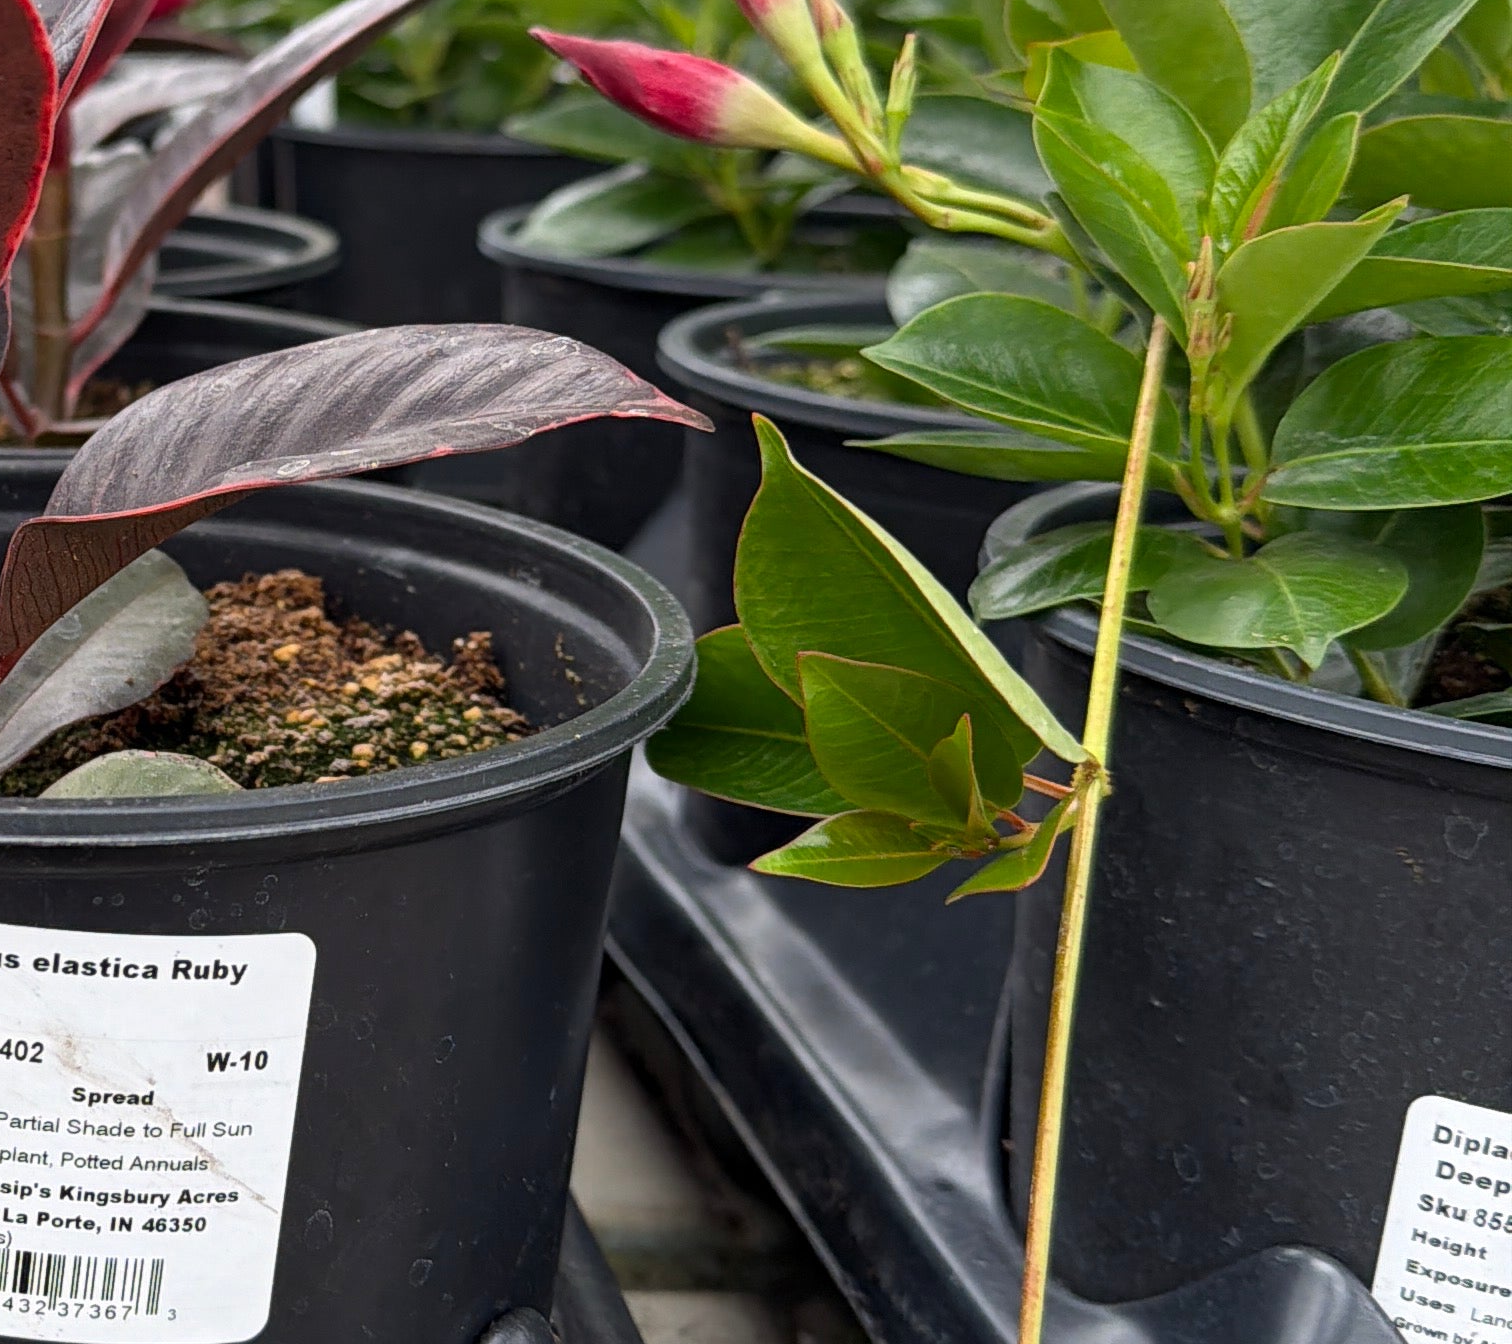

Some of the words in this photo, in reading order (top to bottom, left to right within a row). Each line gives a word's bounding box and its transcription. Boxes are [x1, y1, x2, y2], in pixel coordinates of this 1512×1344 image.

[32, 952, 159, 980] elastica
[171, 959, 249, 986] Ruby
[206, 1050, 269, 1073] W-10
[71, 1086, 155, 1108] Spread
[66, 1118, 136, 1138] Shade
[142, 1123, 163, 1138] to
[169, 1122, 207, 1139] Full
[212, 1121, 253, 1138] Sun
[1432, 1123, 1512, 1161] Dipla
[60, 1151, 124, 1171] Potted
[129, 1155, 210, 1172] Annuals
[1435, 1159, 1512, 1197] Deep
[59, 1184, 171, 1209] Kingsbury
[176, 1188, 239, 1205] Acres
[1417, 1193, 1467, 1222] Sku
[2, 1207, 28, 1225] La
[36, 1211, 102, 1235] Porte,
[109, 1216, 133, 1233] IN
[141, 1216, 207, 1233] 46350
[1412, 1227, 1487, 1260] Height
[1405, 1259, 1511, 1298] Exposure
[57, 1301, 133, 1321] 37367
[167, 1308, 177, 1321] 3
[1399, 1286, 1456, 1314] Uses
[1393, 1316, 1448, 1341] Grown
